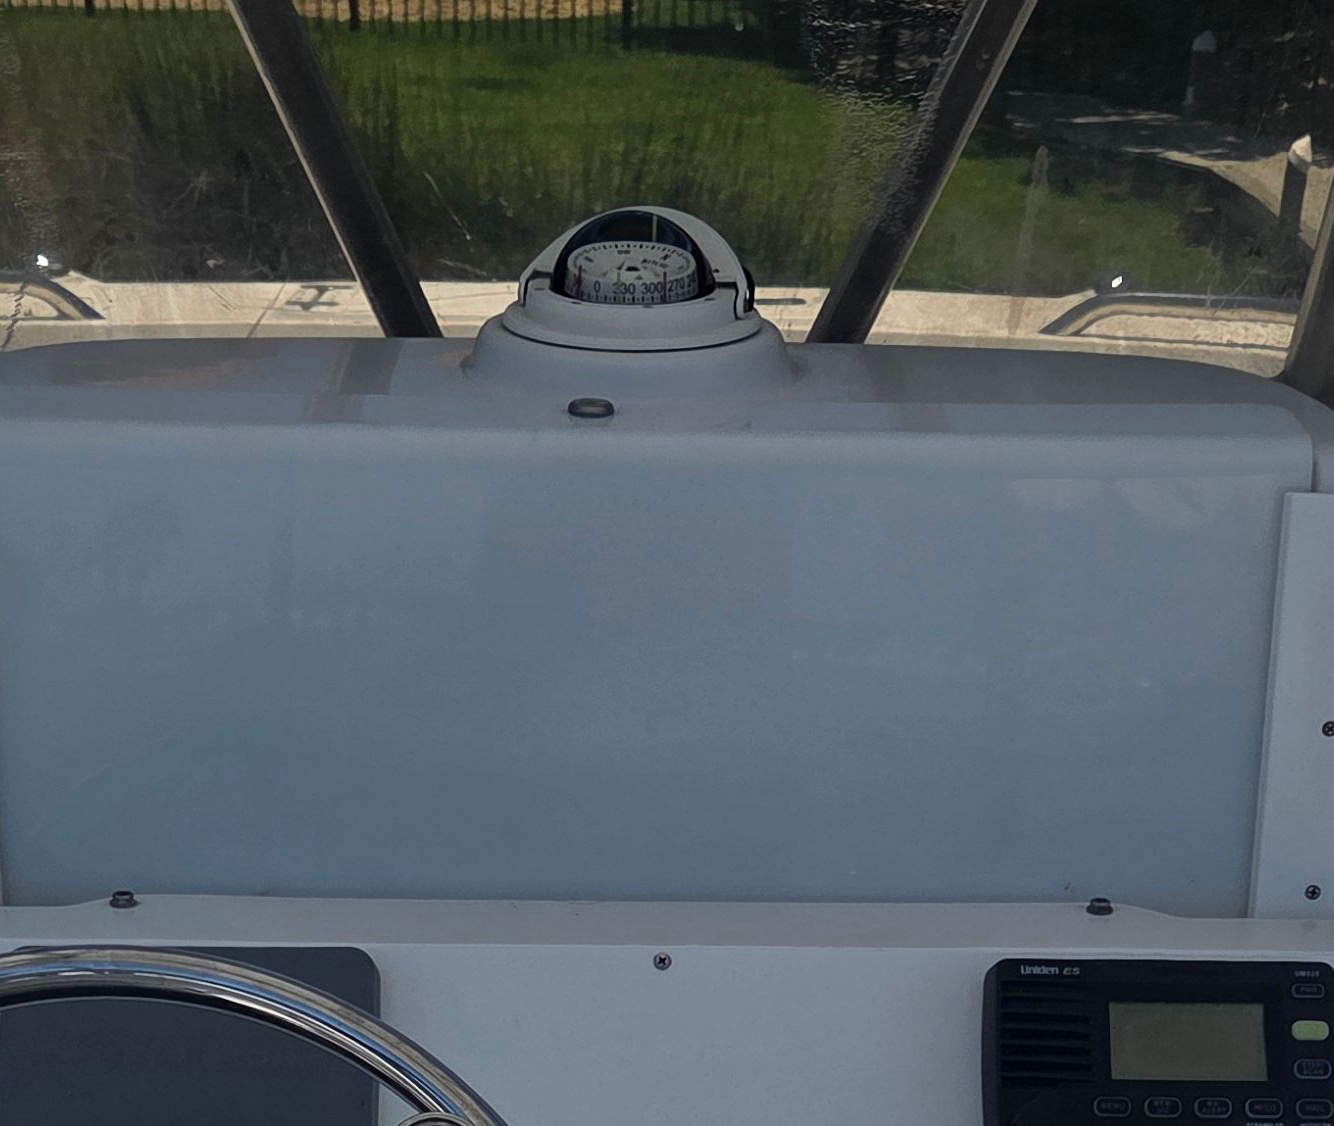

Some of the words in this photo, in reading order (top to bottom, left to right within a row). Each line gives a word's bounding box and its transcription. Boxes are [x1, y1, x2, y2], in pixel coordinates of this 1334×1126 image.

[641, 281, 663, 294] 300
[668, 277, 685, 293] 270
[1020, 964, 1059, 975] Uniden
